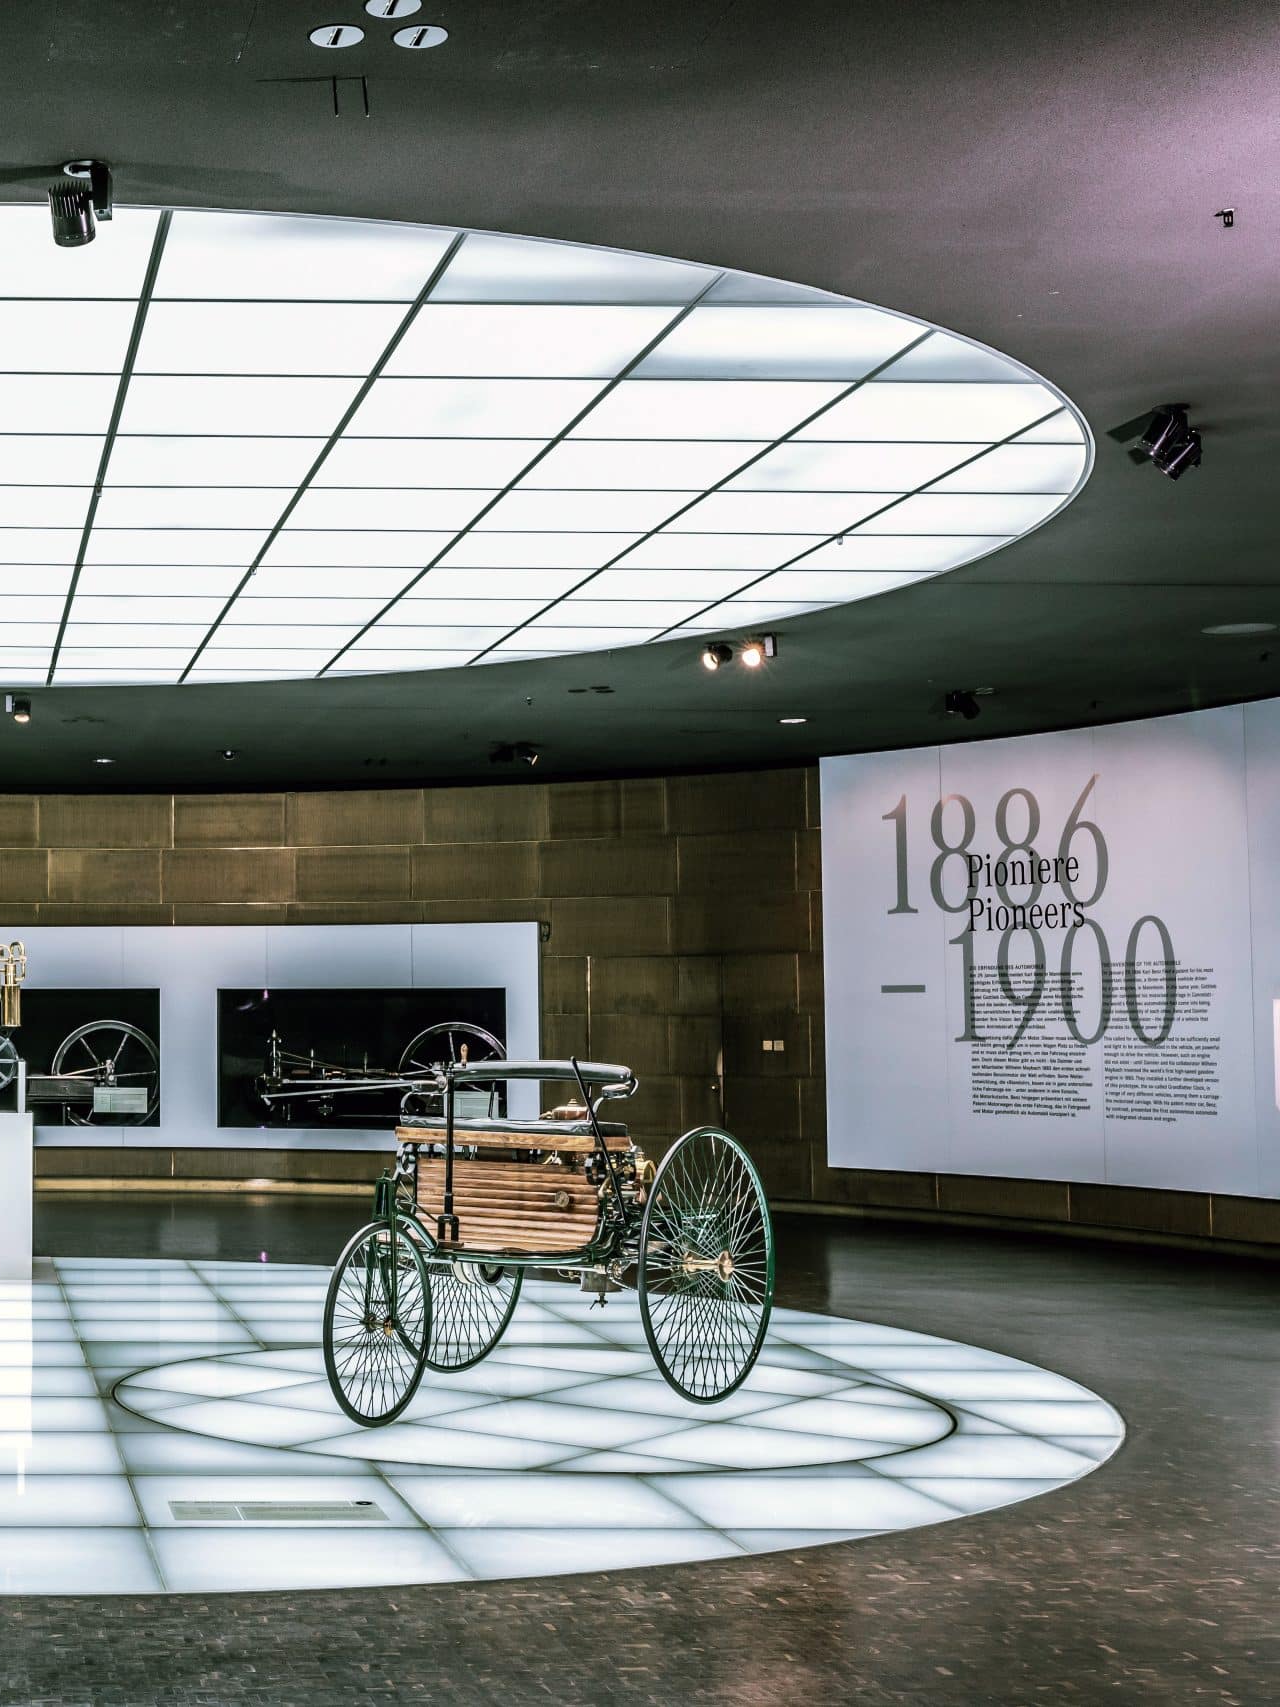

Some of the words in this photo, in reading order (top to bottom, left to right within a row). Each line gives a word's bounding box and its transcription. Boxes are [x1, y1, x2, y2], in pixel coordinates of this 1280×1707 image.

[882, 773, 1109, 914] 1886
[967, 850, 1080, 888] Pioniere
[967, 899, 1085, 931] Pioneers
[949, 915, 1177, 1049] 1900
